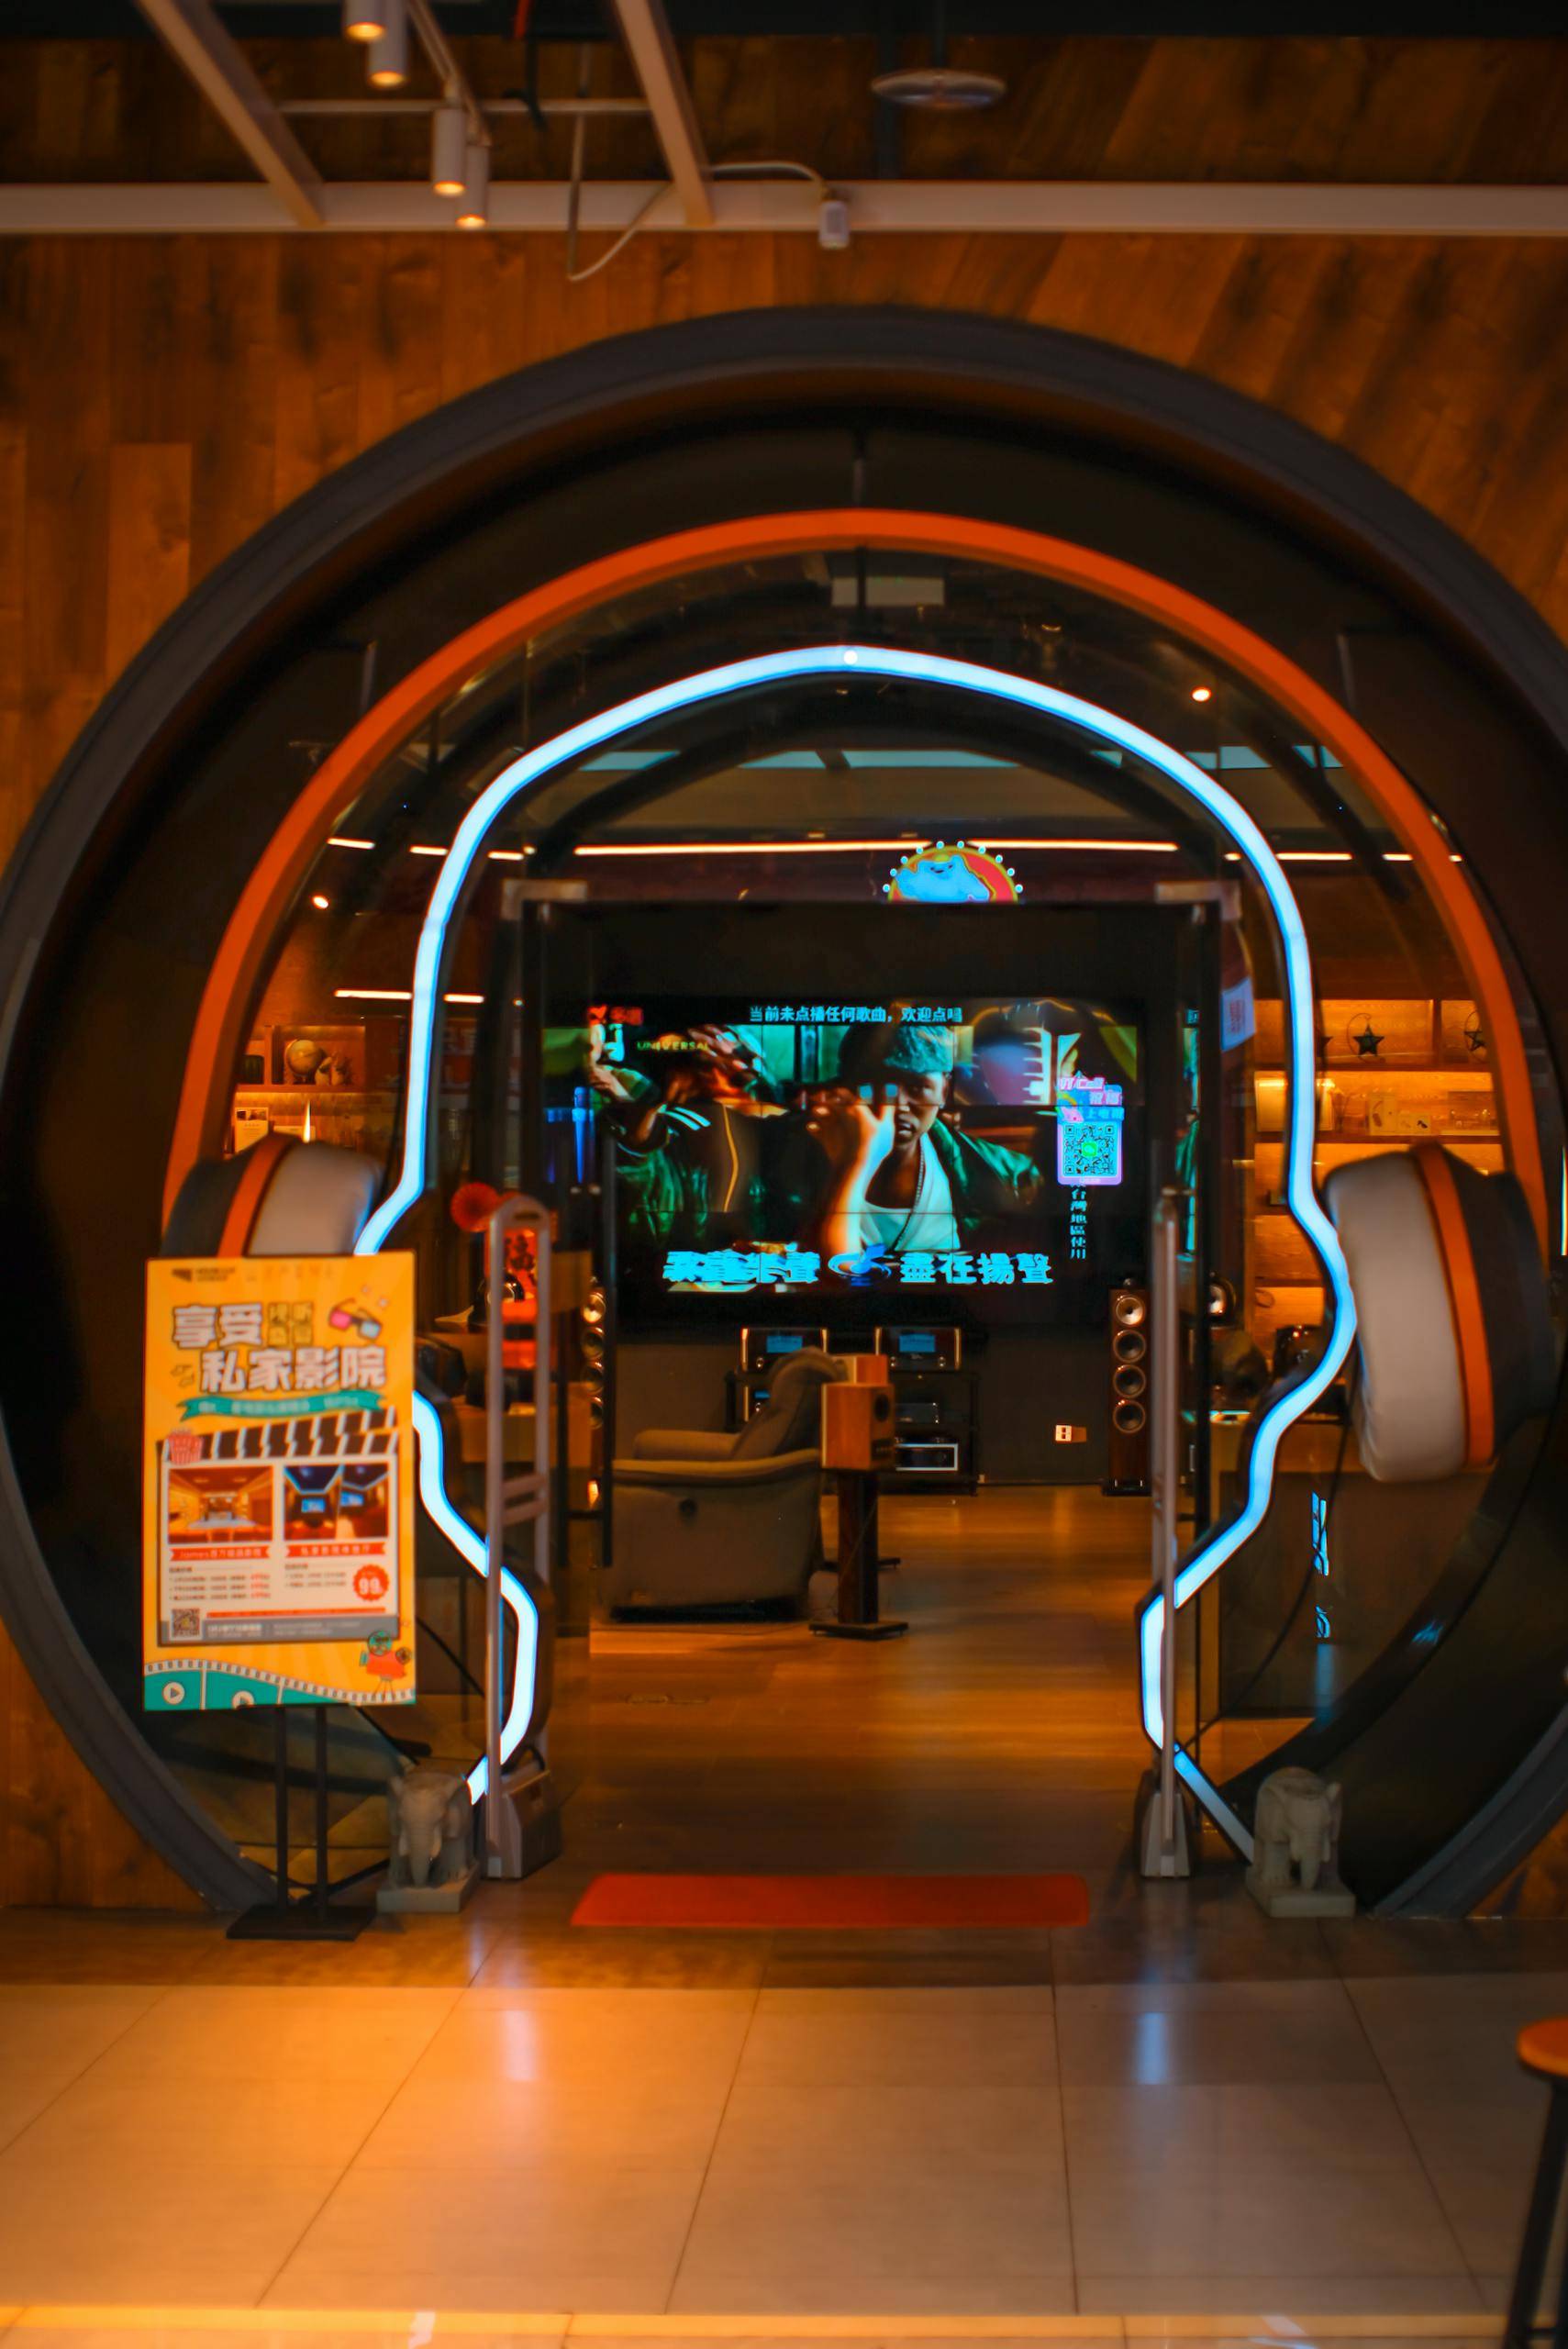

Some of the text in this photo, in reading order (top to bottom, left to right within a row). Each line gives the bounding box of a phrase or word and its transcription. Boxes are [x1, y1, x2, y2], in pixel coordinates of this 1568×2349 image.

[1070, 1184, 1087, 1259] 台灣地區使用
[172, 1303, 262, 1349] 享受
[200, 1346, 385, 1392] 私家影院
